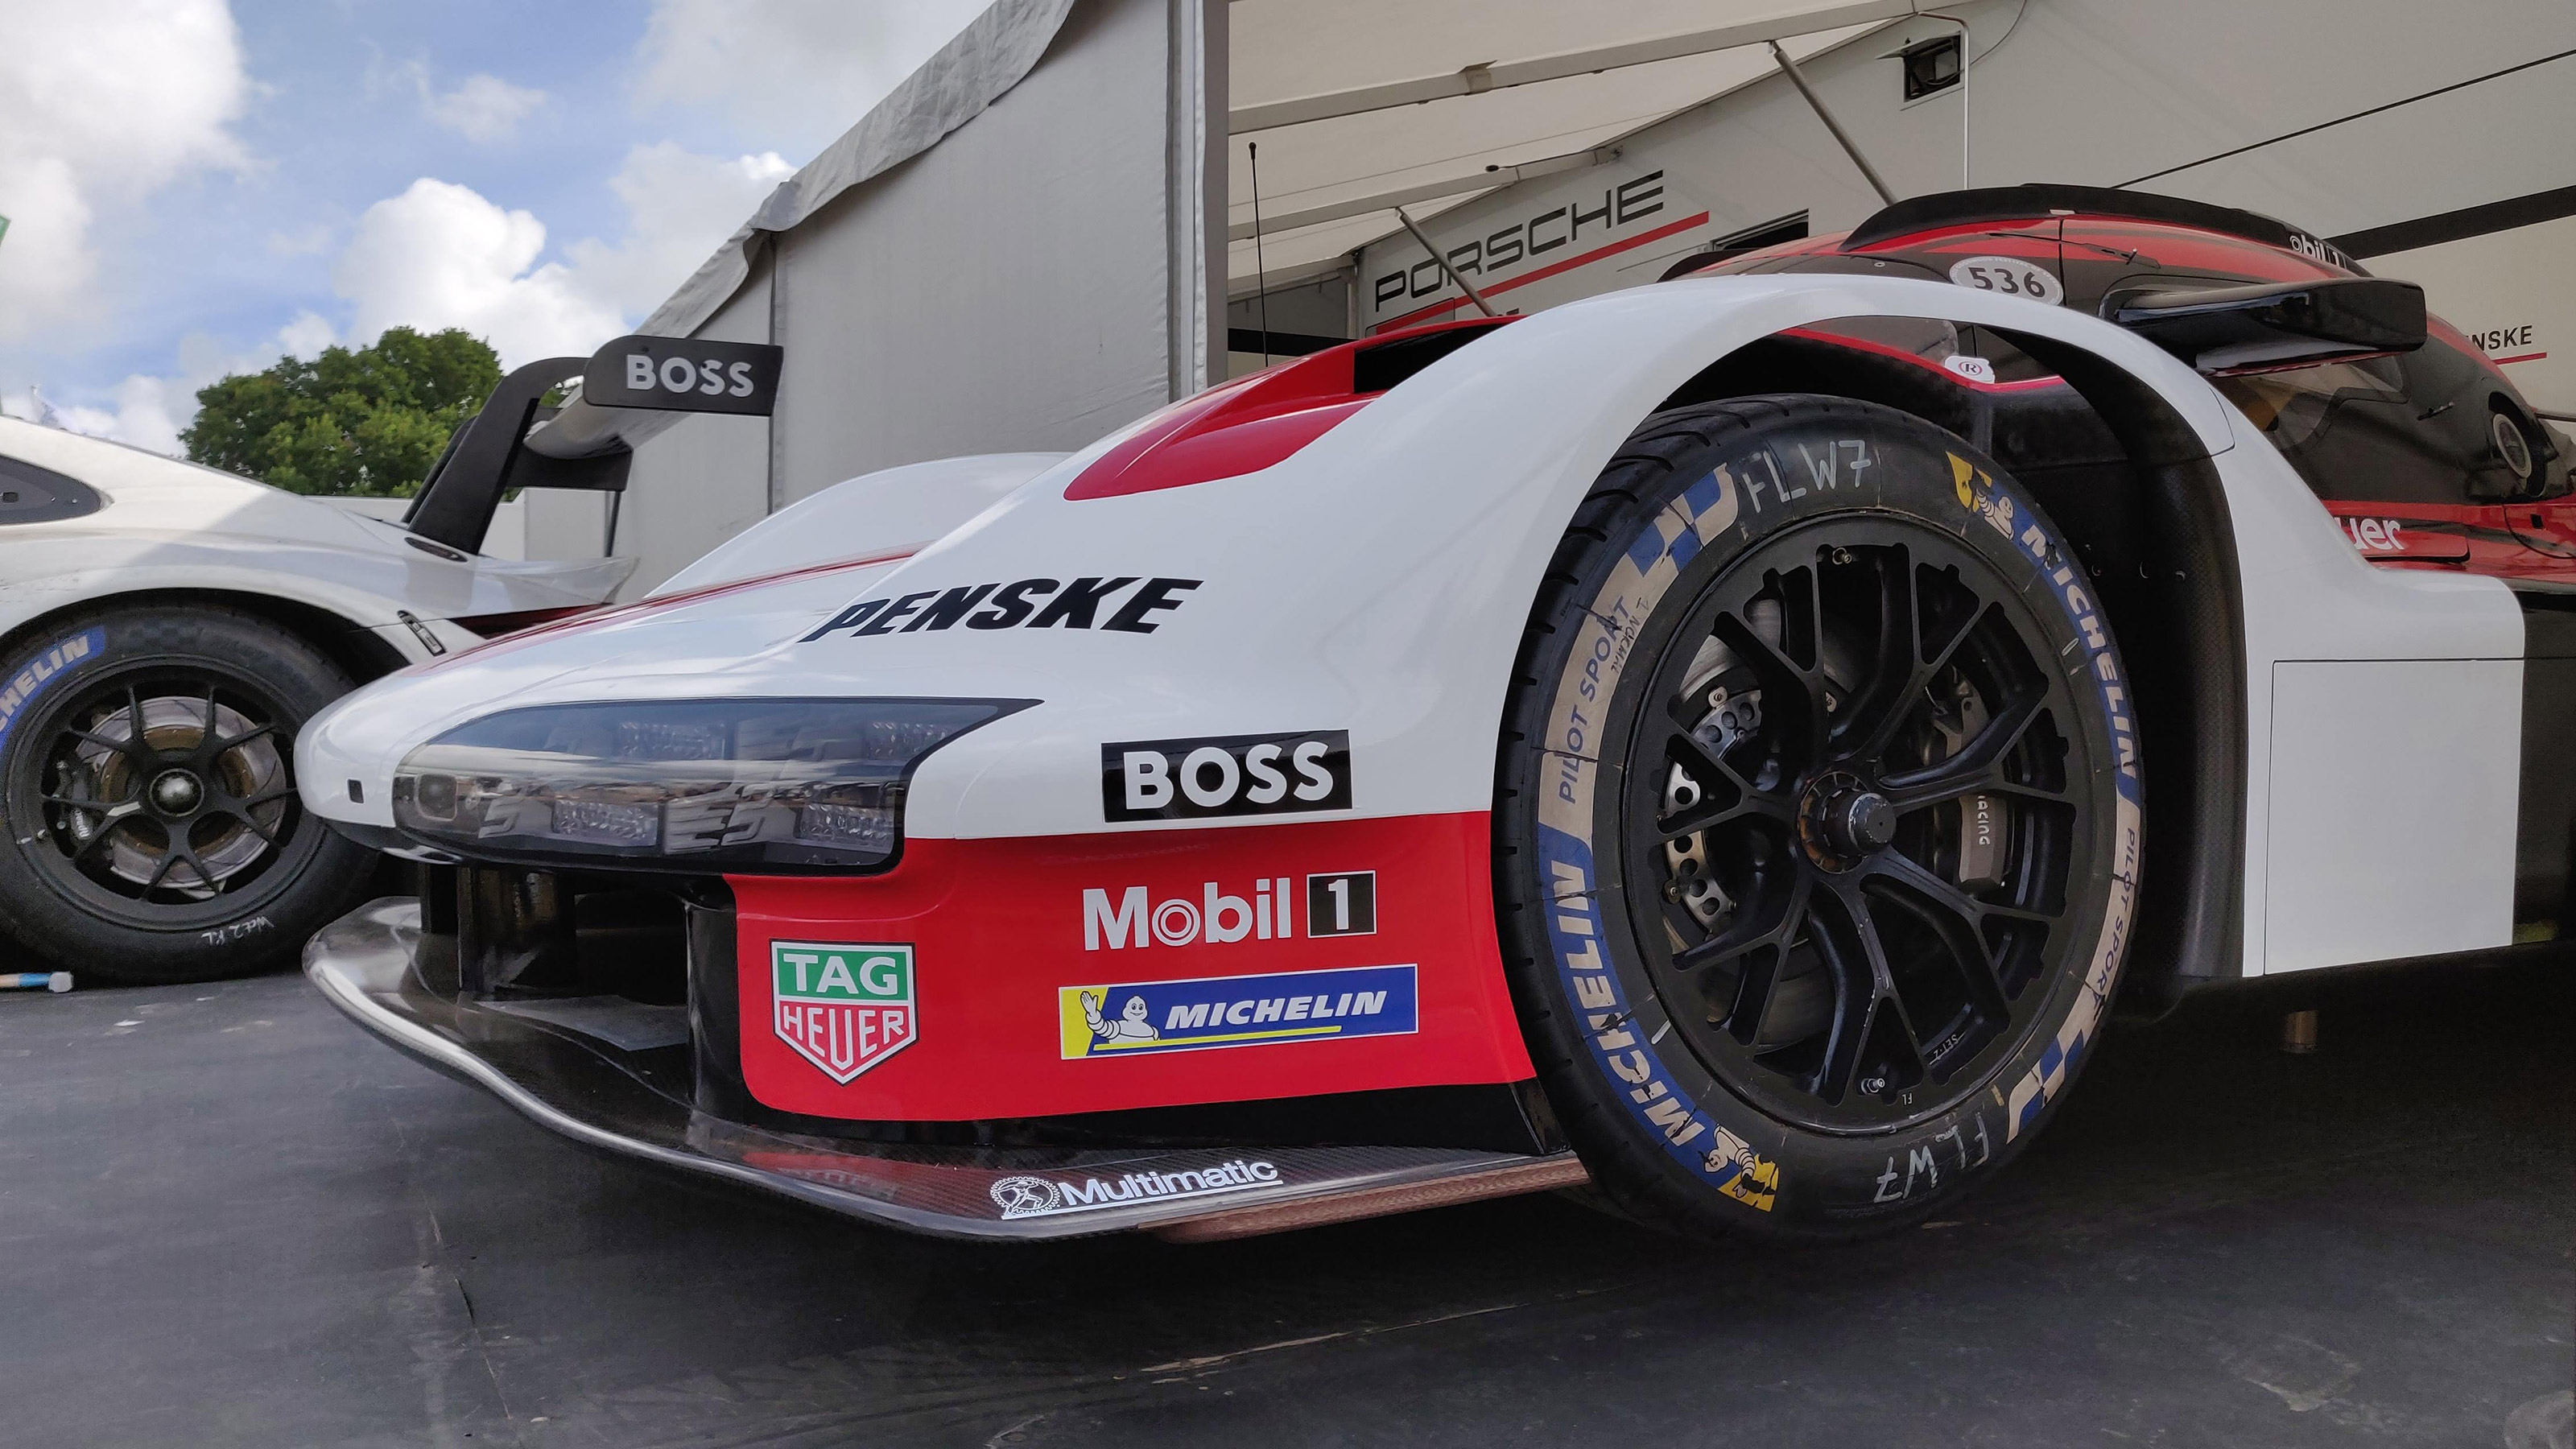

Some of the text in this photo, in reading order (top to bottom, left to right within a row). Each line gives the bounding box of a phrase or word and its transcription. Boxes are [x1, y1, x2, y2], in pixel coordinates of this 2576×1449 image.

[1376, 170, 1663, 312] PORSCHE
[1968, 266, 2046, 298] 536
[2466, 324, 2533, 351] NSKE
[626, 354, 754, 398] BOSS
[798, 576, 1204, 642] PENSKE
[2021, 525, 2137, 778] MICHELIN
[1558, 595, 1629, 804] PILOT SPORT
[1124, 742, 1334, 811] BOSS
[2120, 827, 2136, 912] PILOT
[1083, 877, 1349, 951] Mobil 1
[783, 953, 898, 995] TAG
[1550, 860, 1706, 1146] MICHELIN
[783, 1005, 904, 1071] HEUER
[1165, 991, 1387, 1030] MICHELIN
[1901, 1092, 1913, 1106] FL
[1057, 1160, 1278, 1207] Multimatic
